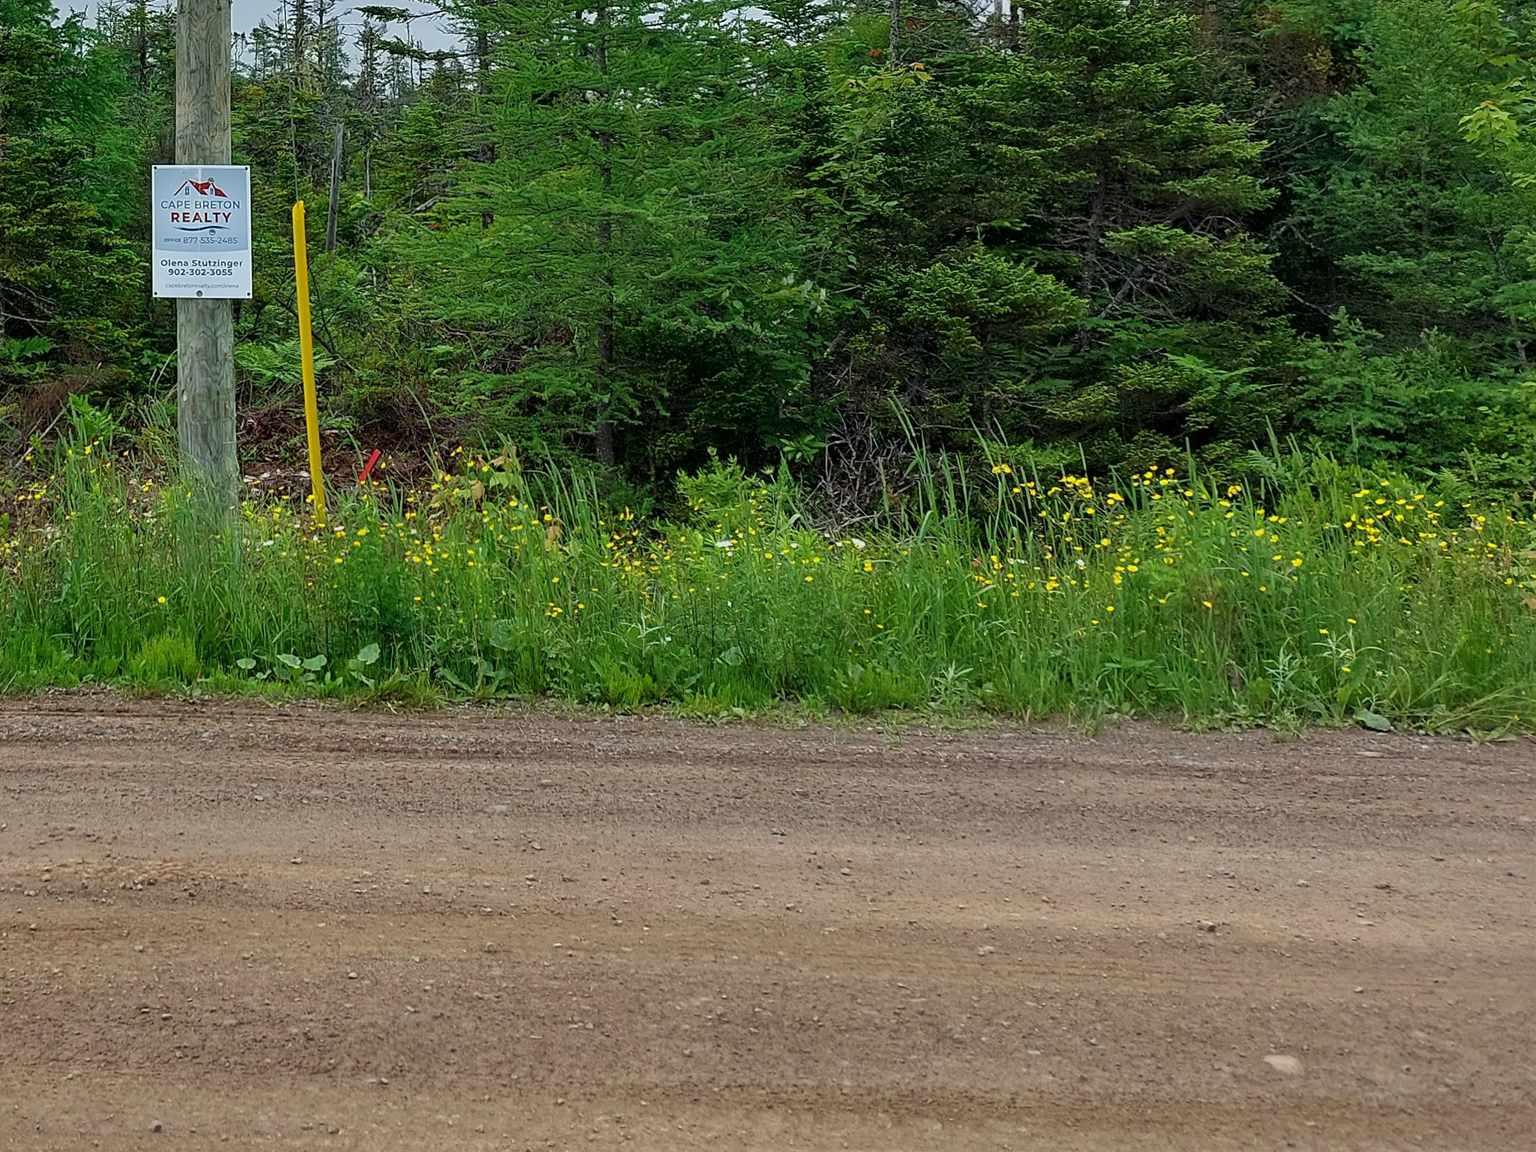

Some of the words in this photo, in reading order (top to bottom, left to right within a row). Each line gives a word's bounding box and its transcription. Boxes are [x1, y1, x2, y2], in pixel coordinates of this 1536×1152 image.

[160, 200, 190, 209] CAPE
[194, 200, 240, 209] BRETON
[171, 212, 232, 223] REALTY
[160, 259, 188, 267] Olena
[192, 259, 243, 268] Stutzinger
[168, 268, 233, 276] 902-302-3055
